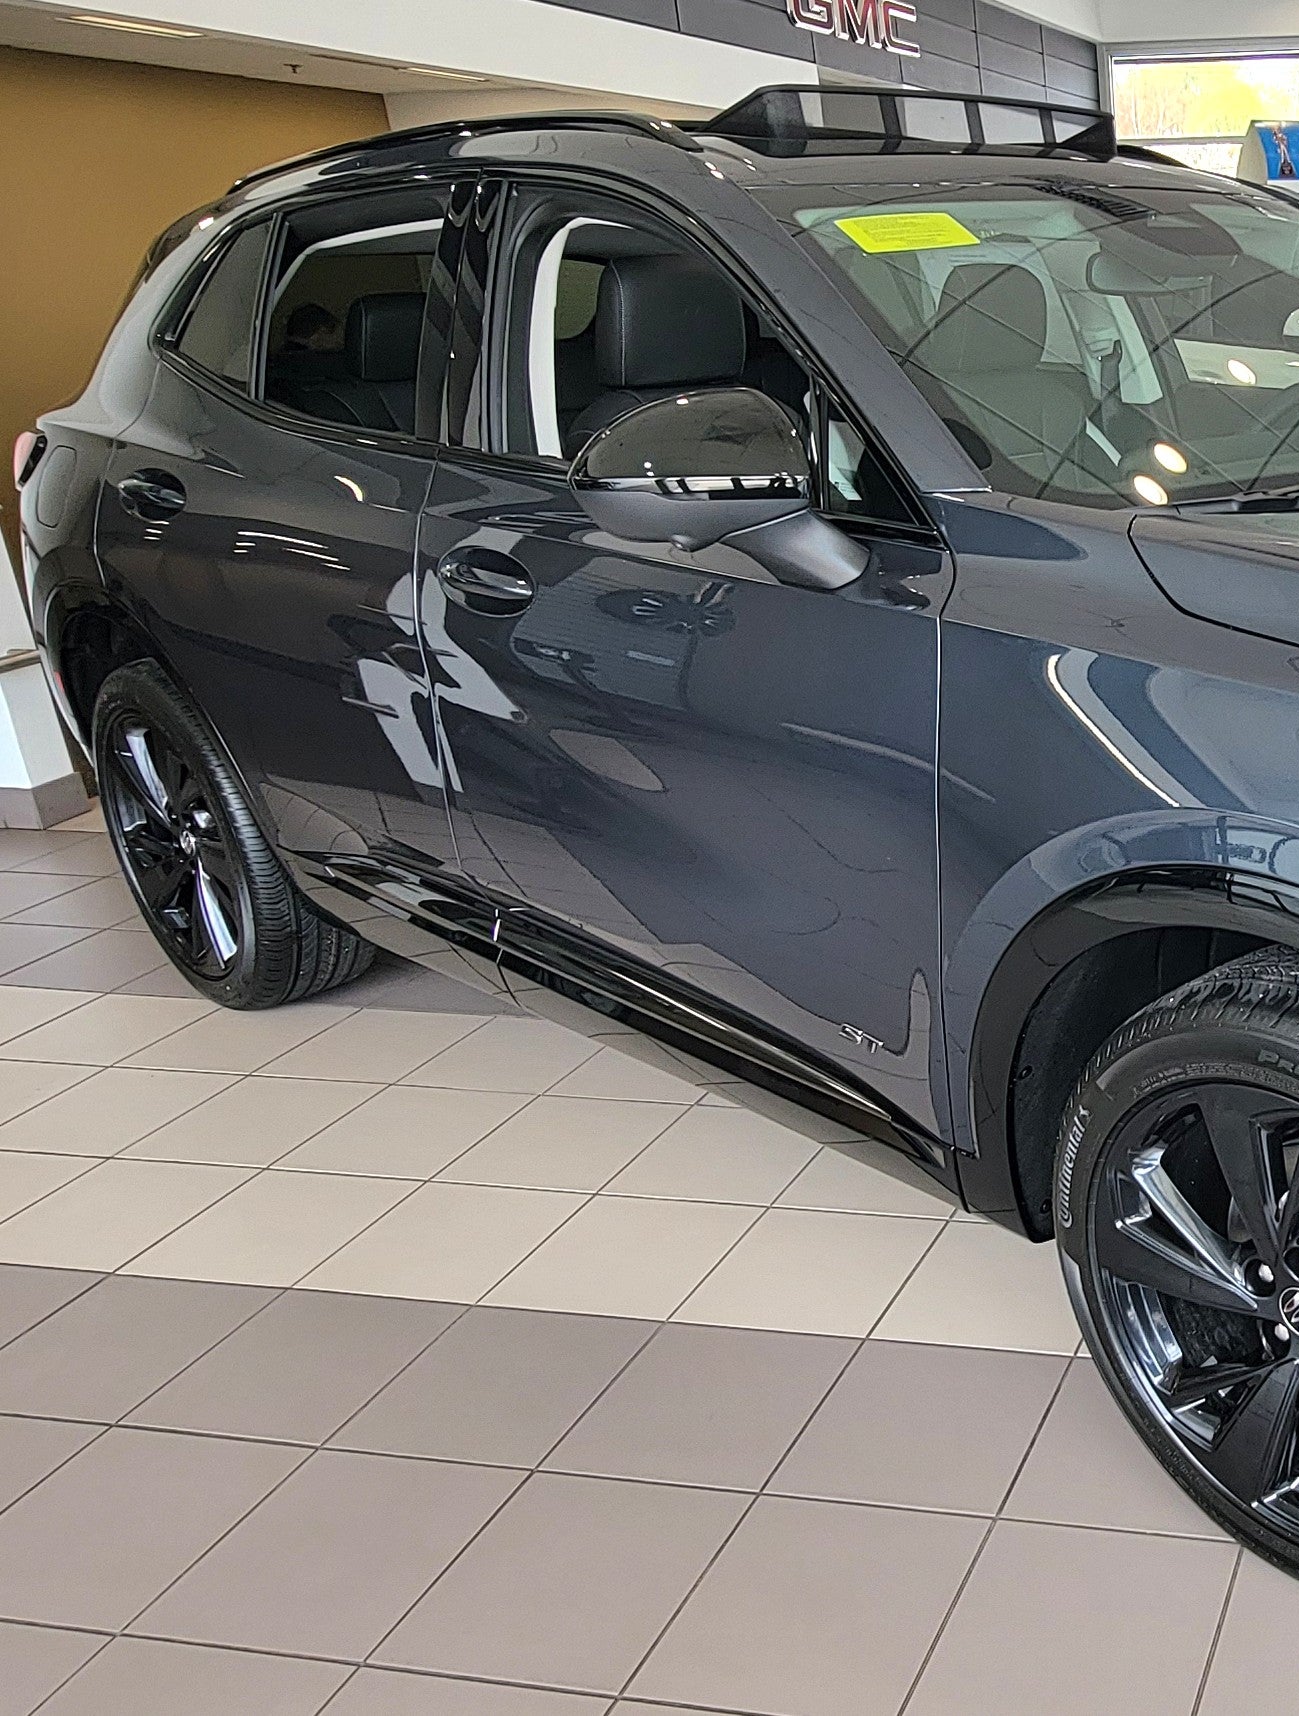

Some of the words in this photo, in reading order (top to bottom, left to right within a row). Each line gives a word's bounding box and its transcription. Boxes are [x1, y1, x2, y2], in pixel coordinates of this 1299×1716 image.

[787, 0, 921, 58] GMC
[839, 1023, 884, 1054] ST
[1059, 1115, 1086, 1229] Continental
